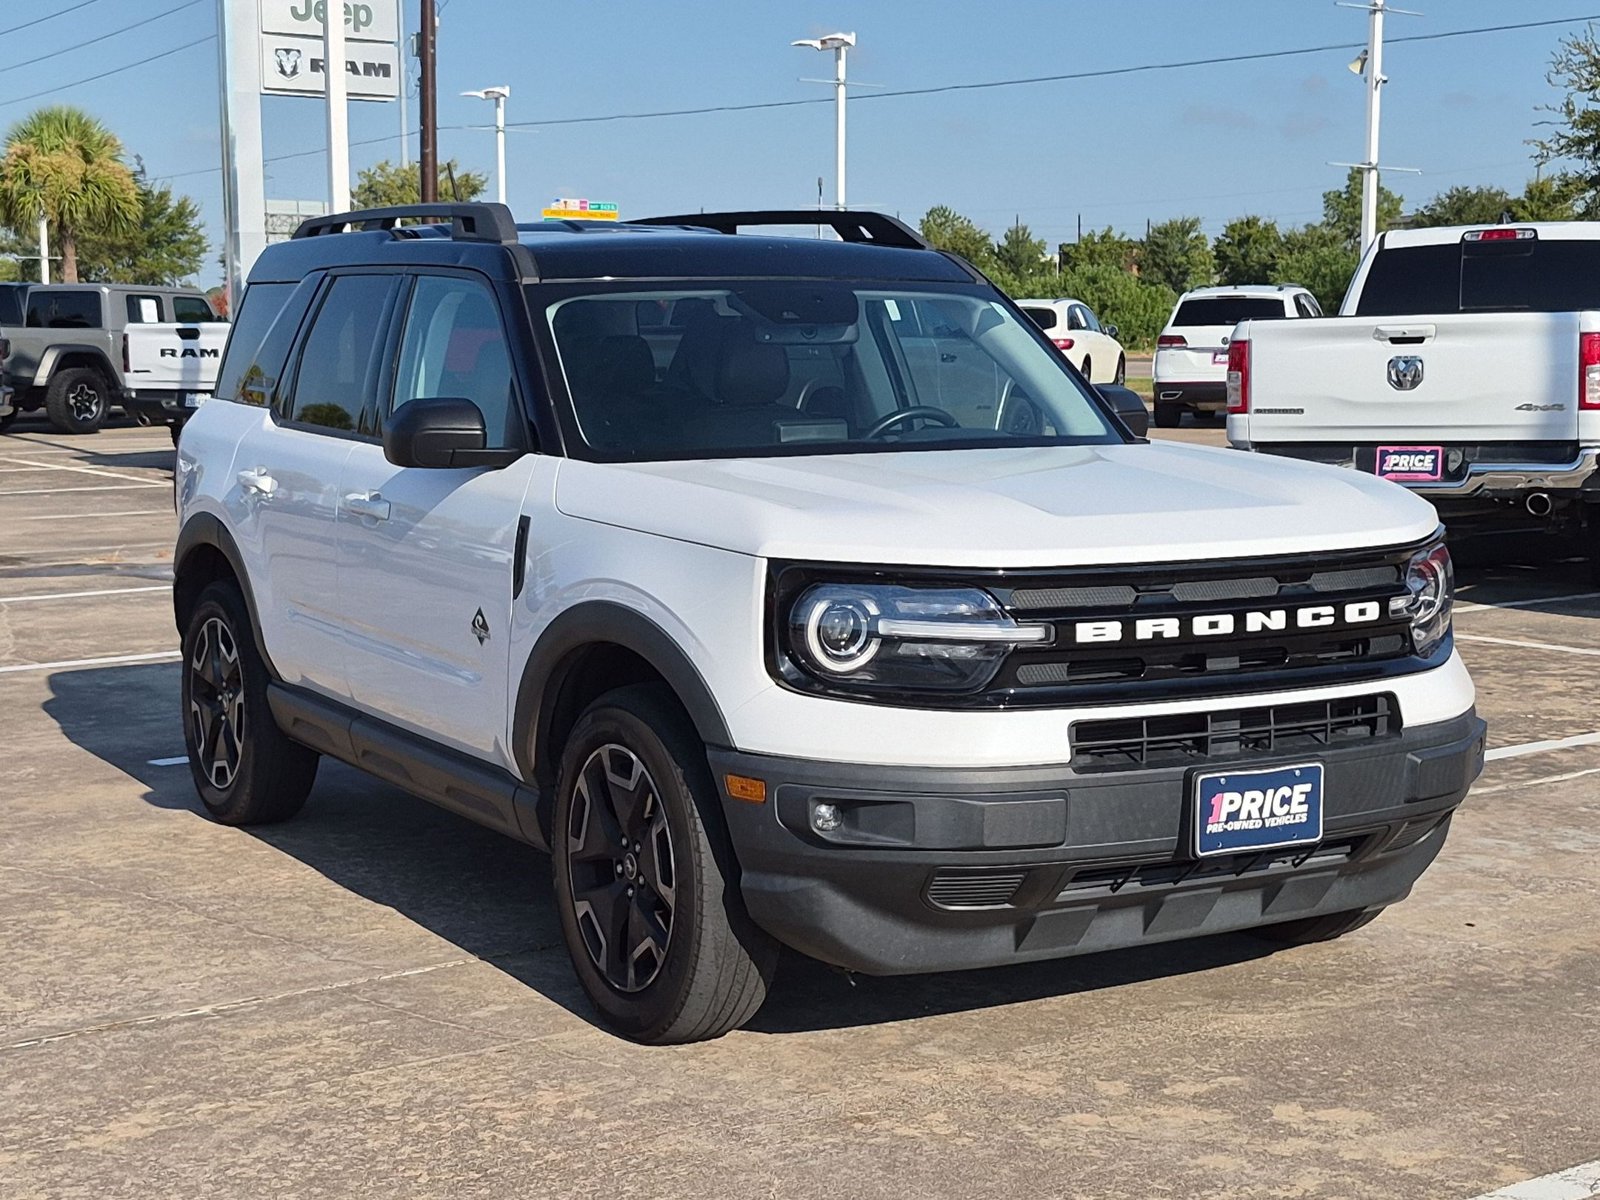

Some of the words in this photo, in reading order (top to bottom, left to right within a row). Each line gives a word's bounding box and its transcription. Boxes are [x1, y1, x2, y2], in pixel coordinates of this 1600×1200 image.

[160, 348, 220, 358] RAM
[1075, 600, 1380, 643] BRONCO
[1206, 819, 1263, 834] PRE-OWNED
[1264, 812, 1308, 828] VEHICLES
